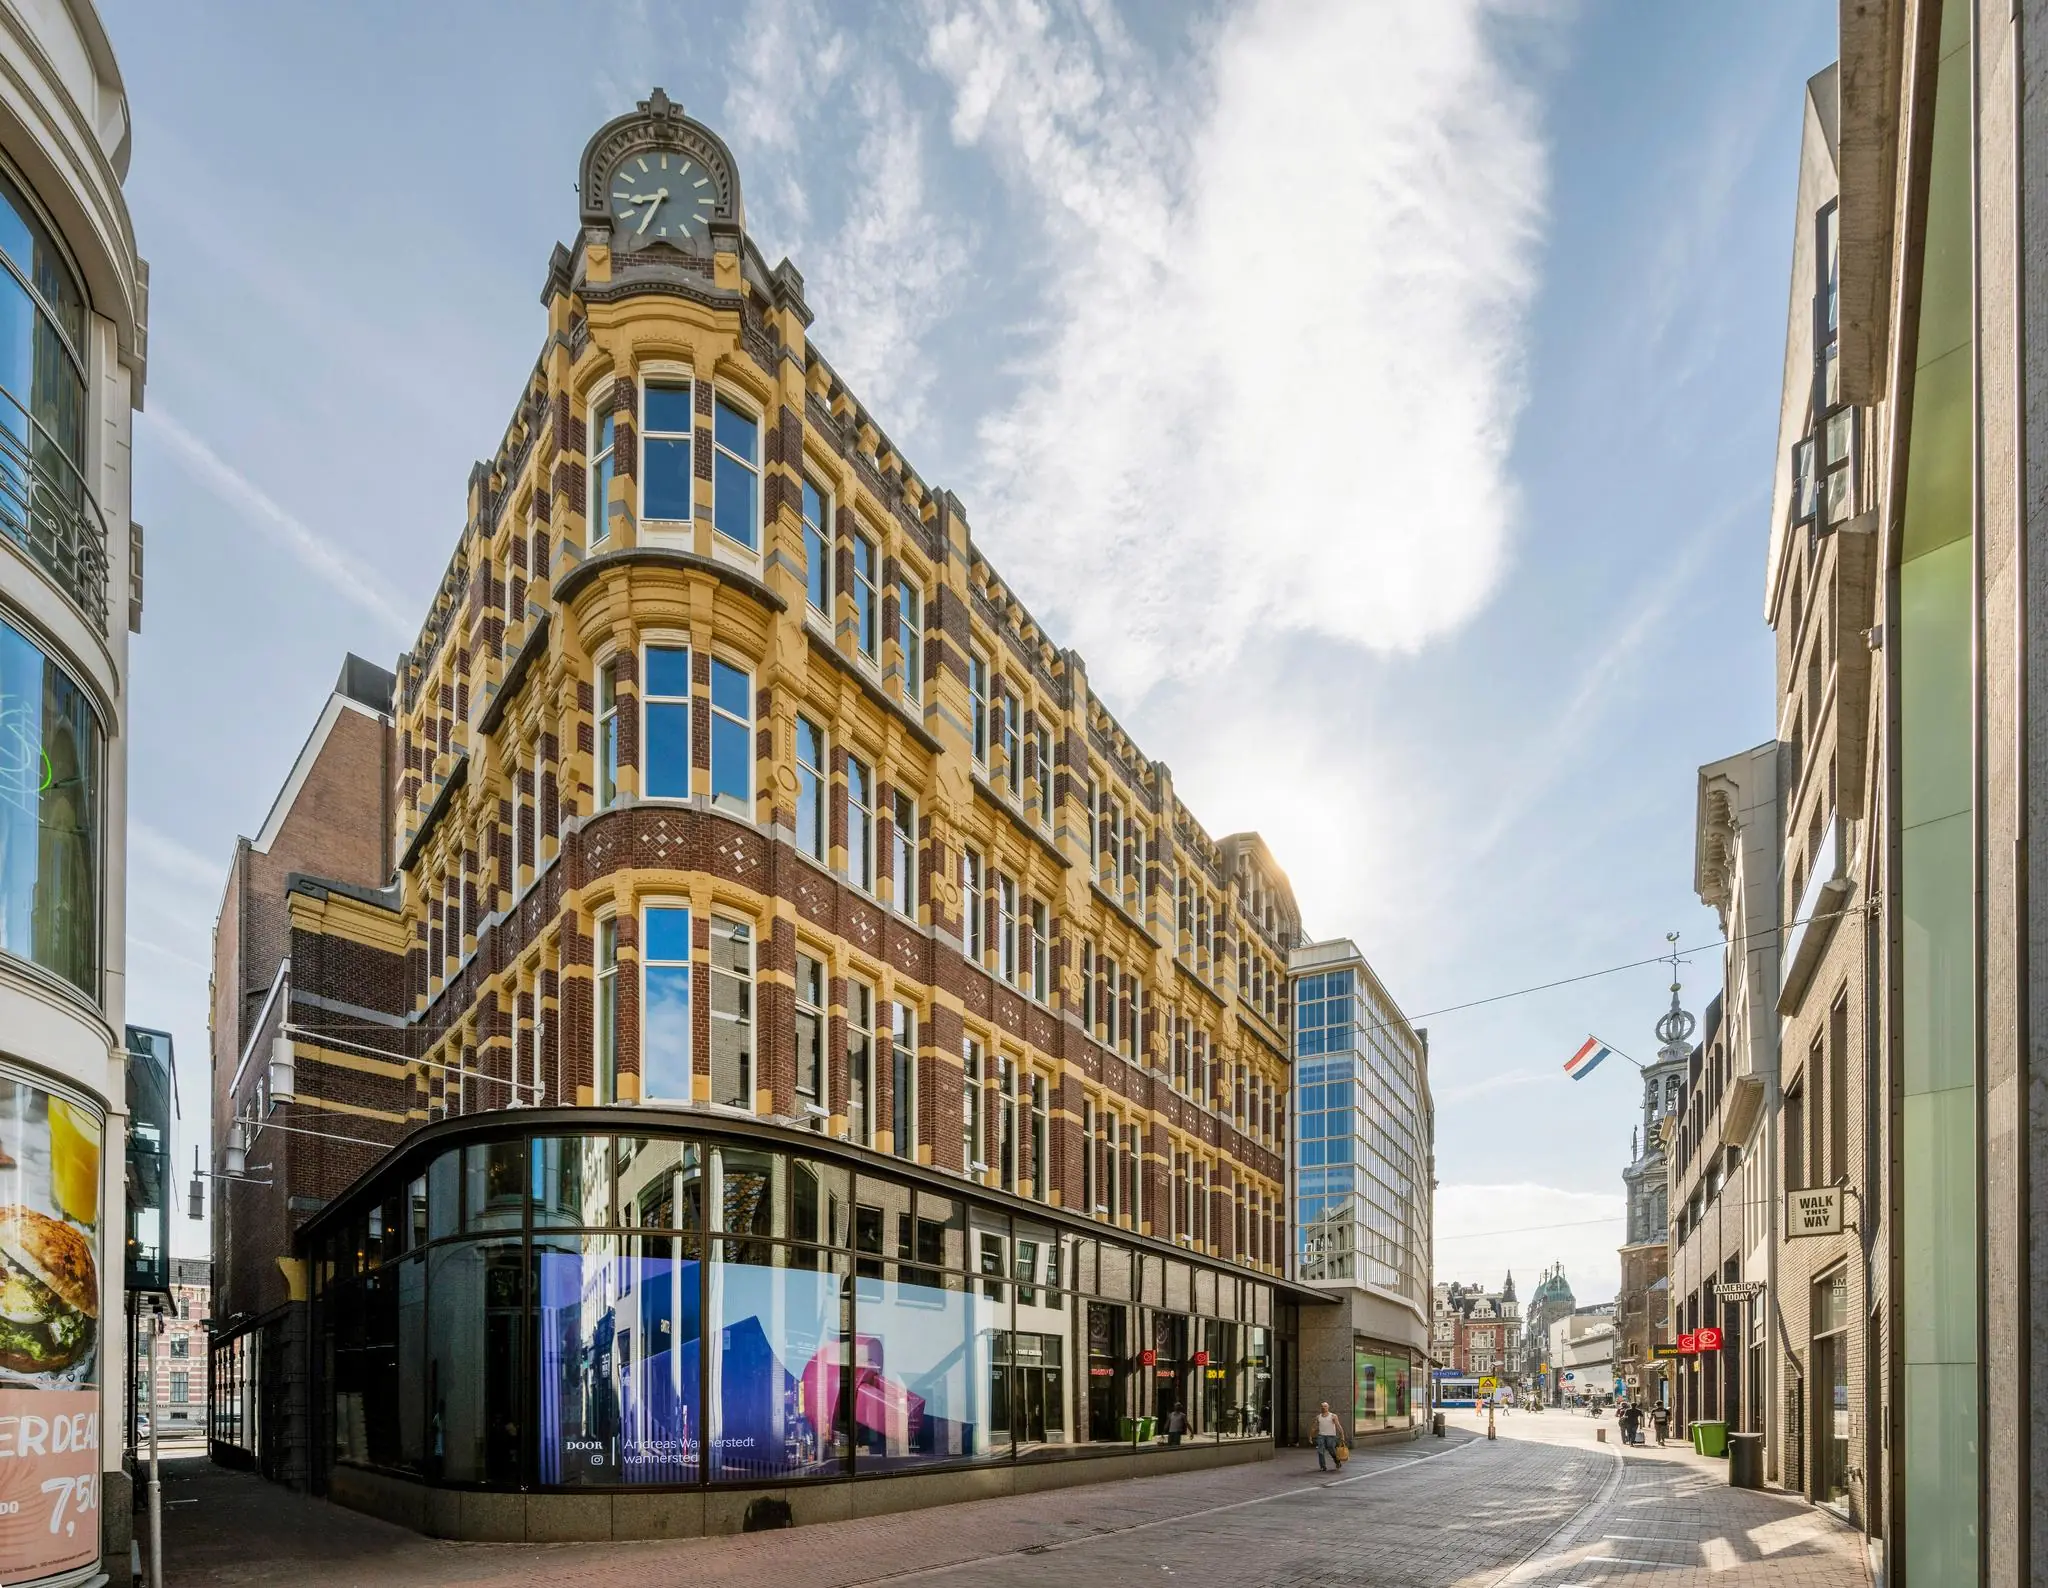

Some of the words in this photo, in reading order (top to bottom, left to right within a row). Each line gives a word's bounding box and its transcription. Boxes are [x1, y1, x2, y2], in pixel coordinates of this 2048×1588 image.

[1799, 1195, 1834, 1209] WALK
[1804, 1208, 1829, 1216] THIS
[1803, 1215, 1830, 1228] WAY
[1715, 1282, 1758, 1293] AMERICA
[1724, 1292, 1750, 1301] TODAY
[566, 1440, 604, 1450] DOOR
[623, 1437, 677, 1449] Andreas
[679, 1436, 755, 1449] Wanerstedt
[623, 1452, 700, 1465] wannersted
